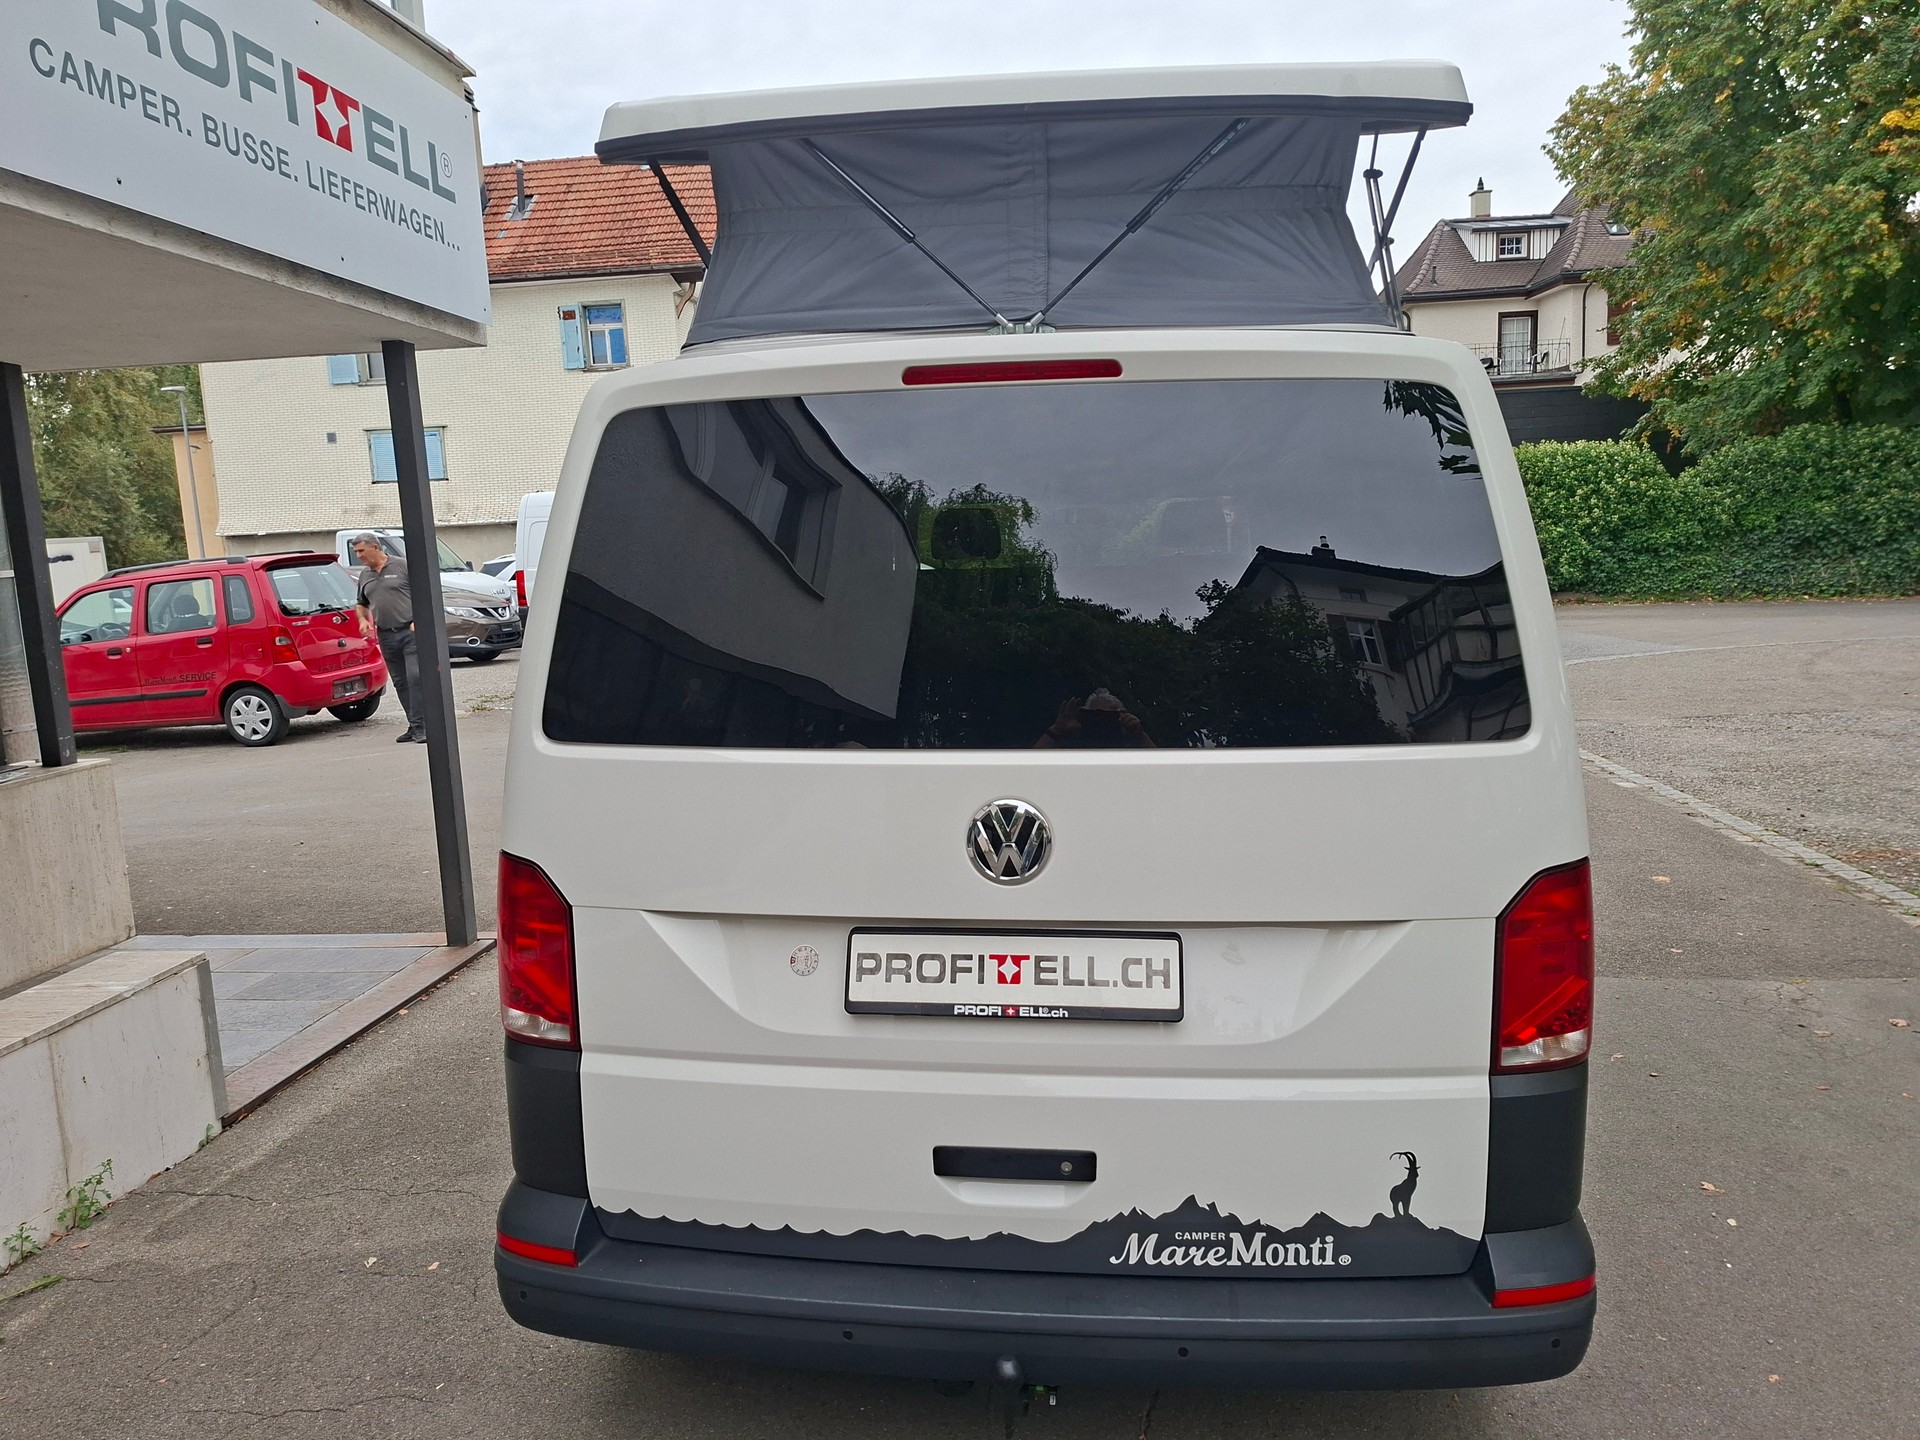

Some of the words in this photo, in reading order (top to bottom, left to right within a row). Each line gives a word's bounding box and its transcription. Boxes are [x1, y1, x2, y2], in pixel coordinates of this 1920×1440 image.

[29, 37, 193, 137] CAMPER.
[202, 112, 299, 183] BUSSE.
[305, 160, 461, 252] LIEFERWAGEN...
[179, 671, 217, 683] SERVICE
[1175, 1231, 1226, 1241] CAMPER
